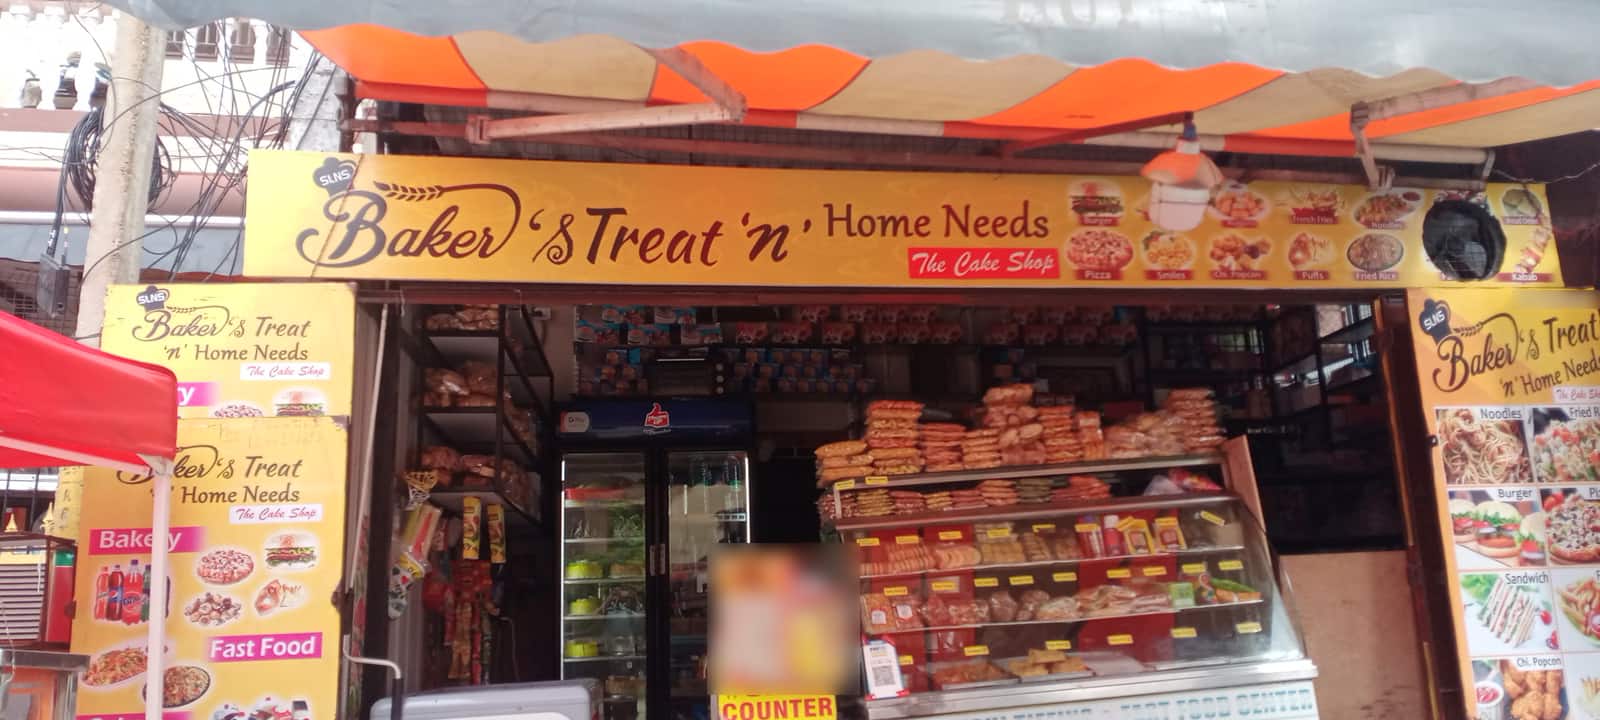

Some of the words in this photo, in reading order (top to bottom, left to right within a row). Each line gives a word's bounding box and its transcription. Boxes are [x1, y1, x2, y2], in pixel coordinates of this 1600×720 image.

[319, 170, 351, 187] SLNS
[296, 183, 521, 268] Baker
[587, 207, 723, 266] Treat
[823, 203, 931, 238] Home
[941, 200, 1049, 238] Needs
[912, 252, 947, 274] The
[953, 252, 1000, 276] Cake
[1006, 250, 1055, 274] Shop
[1084, 270, 1112, 280] Pizza
[1356, 272, 1377, 280] Fried
[137, 292, 165, 304] SLNS
[132, 306, 230, 342] Baker
[255, 315, 311, 338] Treat
[194, 344, 248, 361] Home
[253, 342, 309, 361] Needs
[1432, 313, 1519, 393] Baker
[1543, 312, 1597, 353] Treat
[247, 366, 264, 377] The
[268, 366, 294, 378] Cake
[299, 365, 324, 377] Shop
[1521, 370, 1561, 395] Home
[1562, 348, 1600, 381] Need
[1480, 409, 1522, 419] Noodles
[1569, 407, 1592, 418] Fried
[244, 456, 302, 478] Treat
[181, 486, 237, 504] Home
[243, 483, 300, 503] Needs
[1497, 488, 1533, 501] Burger
[236, 508, 255, 520] The
[258, 508, 285, 521] Cake
[289, 508, 316, 520] Shop
[99, 530, 181, 552] Bakey
[1505, 572, 1549, 585] Sandwich
[210, 639, 255, 659] Fast
[260, 636, 315, 657] Food
[722, 697, 833, 720] COUNTER
